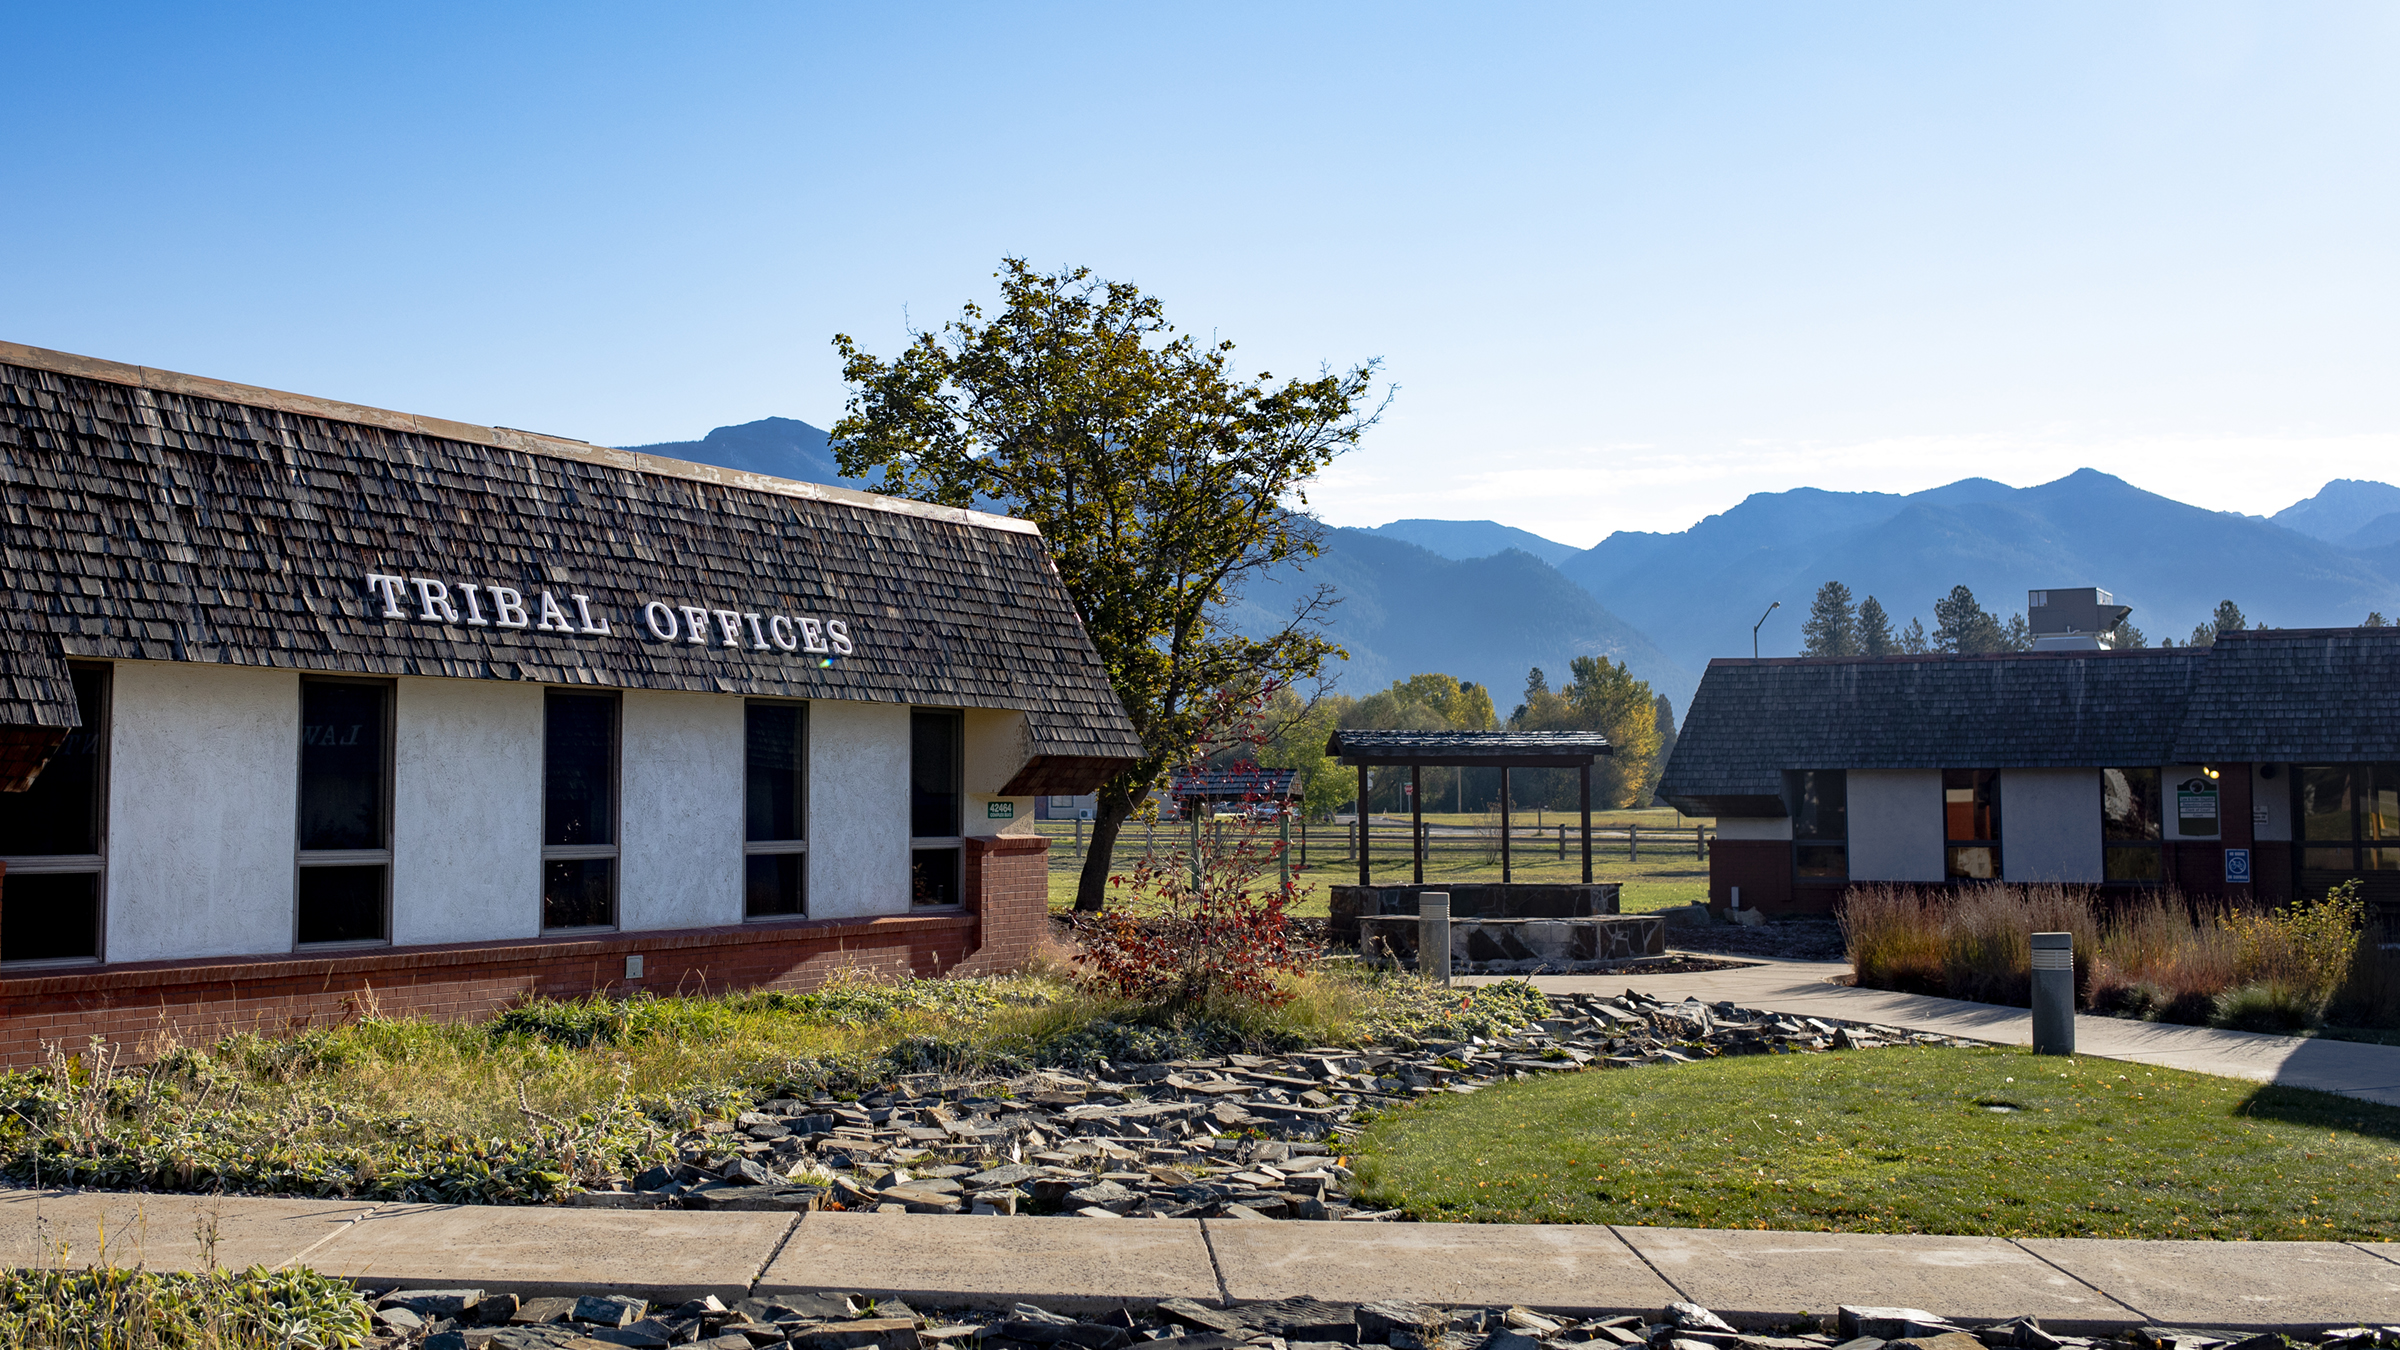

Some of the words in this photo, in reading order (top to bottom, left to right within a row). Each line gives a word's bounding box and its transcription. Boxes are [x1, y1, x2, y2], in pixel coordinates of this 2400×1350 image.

[365, 573, 611, 636] TRIBAL
[644, 600, 853, 656] OFFICES
[990, 803, 1012, 813] 42464
